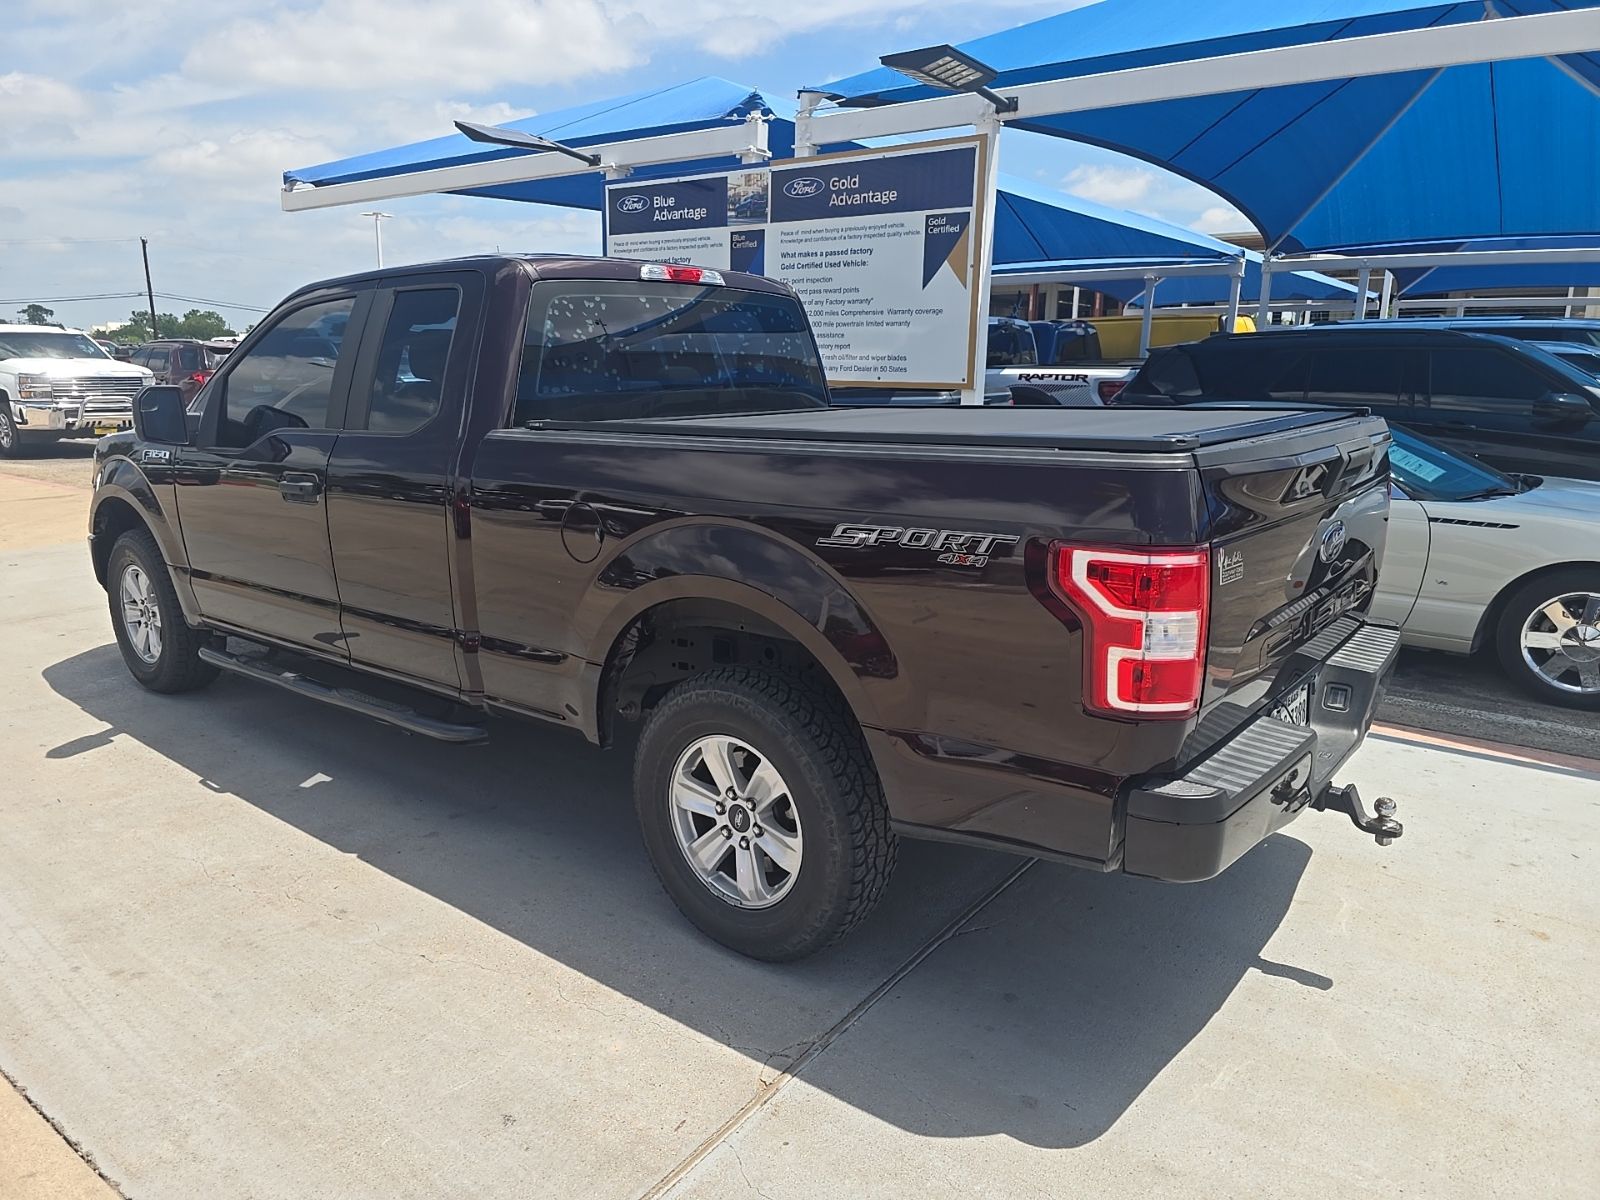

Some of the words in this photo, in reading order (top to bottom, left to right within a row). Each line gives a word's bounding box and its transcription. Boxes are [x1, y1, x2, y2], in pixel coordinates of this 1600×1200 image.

[789, 180, 819, 195] Ford
[829, 175, 859, 190] Gold
[653, 196, 675, 208] Blue
[829, 189, 898, 207] Advantage
[621, 197, 644, 211] Ford
[653, 207, 707, 222] Advantage
[928, 216, 946, 226] Gold
[928, 224, 960, 234] Certified
[732, 234, 746, 242] Blue
[732, 240, 757, 249] Certified
[825, 248, 848, 258] passed
[849, 247, 874, 256] factory
[780, 262, 795, 270] Gold
[796, 261, 823, 270] Certified
[824, 260, 841, 268] Used
[842, 259, 869, 267] Vehicle:
[791, 276, 804, 285] point
[806, 276, 833, 284] inspection
[809, 288, 822, 296] pass
[822, 286, 842, 294] reward
[842, 286, 860, 294] points
[825, 298, 845, 306] Factory
[840, 308, 884, 317] Comprehensive
[887, 308, 913, 316] Warranty
[914, 308, 943, 316] coverage
[836, 320, 864, 328] powertrain
[865, 319, 884, 327] limited
[885, 320, 910, 328] warranty
[834, 343, 850, 351] report
[870, 353, 886, 362] wiper
[839, 364, 852, 372] Ford
[853, 364, 872, 372] Dealer
[873, 364, 878, 372] in
[879, 365, 888, 373] 50
[888, 365, 908, 373] States
[1018, 373, 1090, 385] RAPTOR
[815, 523, 1020, 555] SPORT
